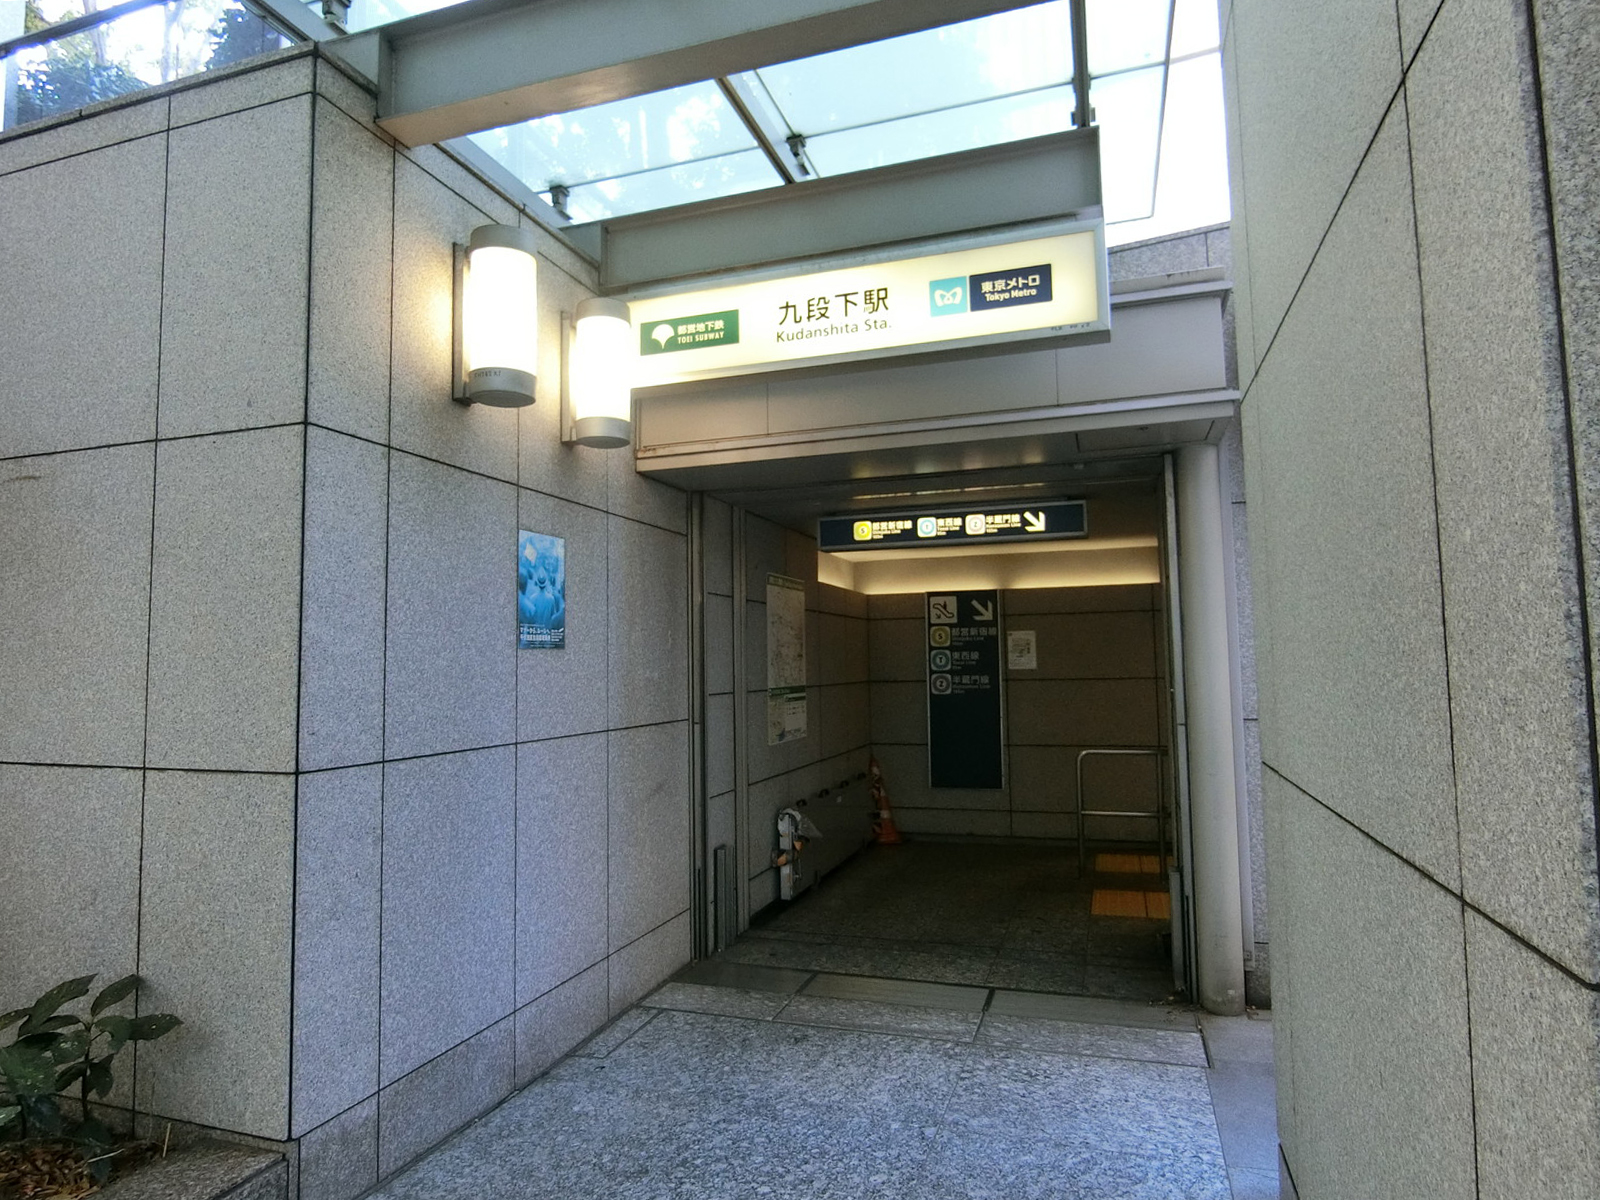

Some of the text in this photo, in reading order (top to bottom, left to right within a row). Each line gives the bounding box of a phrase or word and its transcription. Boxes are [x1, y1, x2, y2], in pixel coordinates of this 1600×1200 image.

[981, 274, 1040, 293] 東京メトロ
[985, 287, 1037, 302] Tokyo Metro
[779, 287, 888, 325] 九段下駅
[677, 319, 724, 335] 都営地下鉄
[776, 319, 892, 343] Kudanshita Sta.
[677, 331, 724, 344] TOEI SUBWAY
